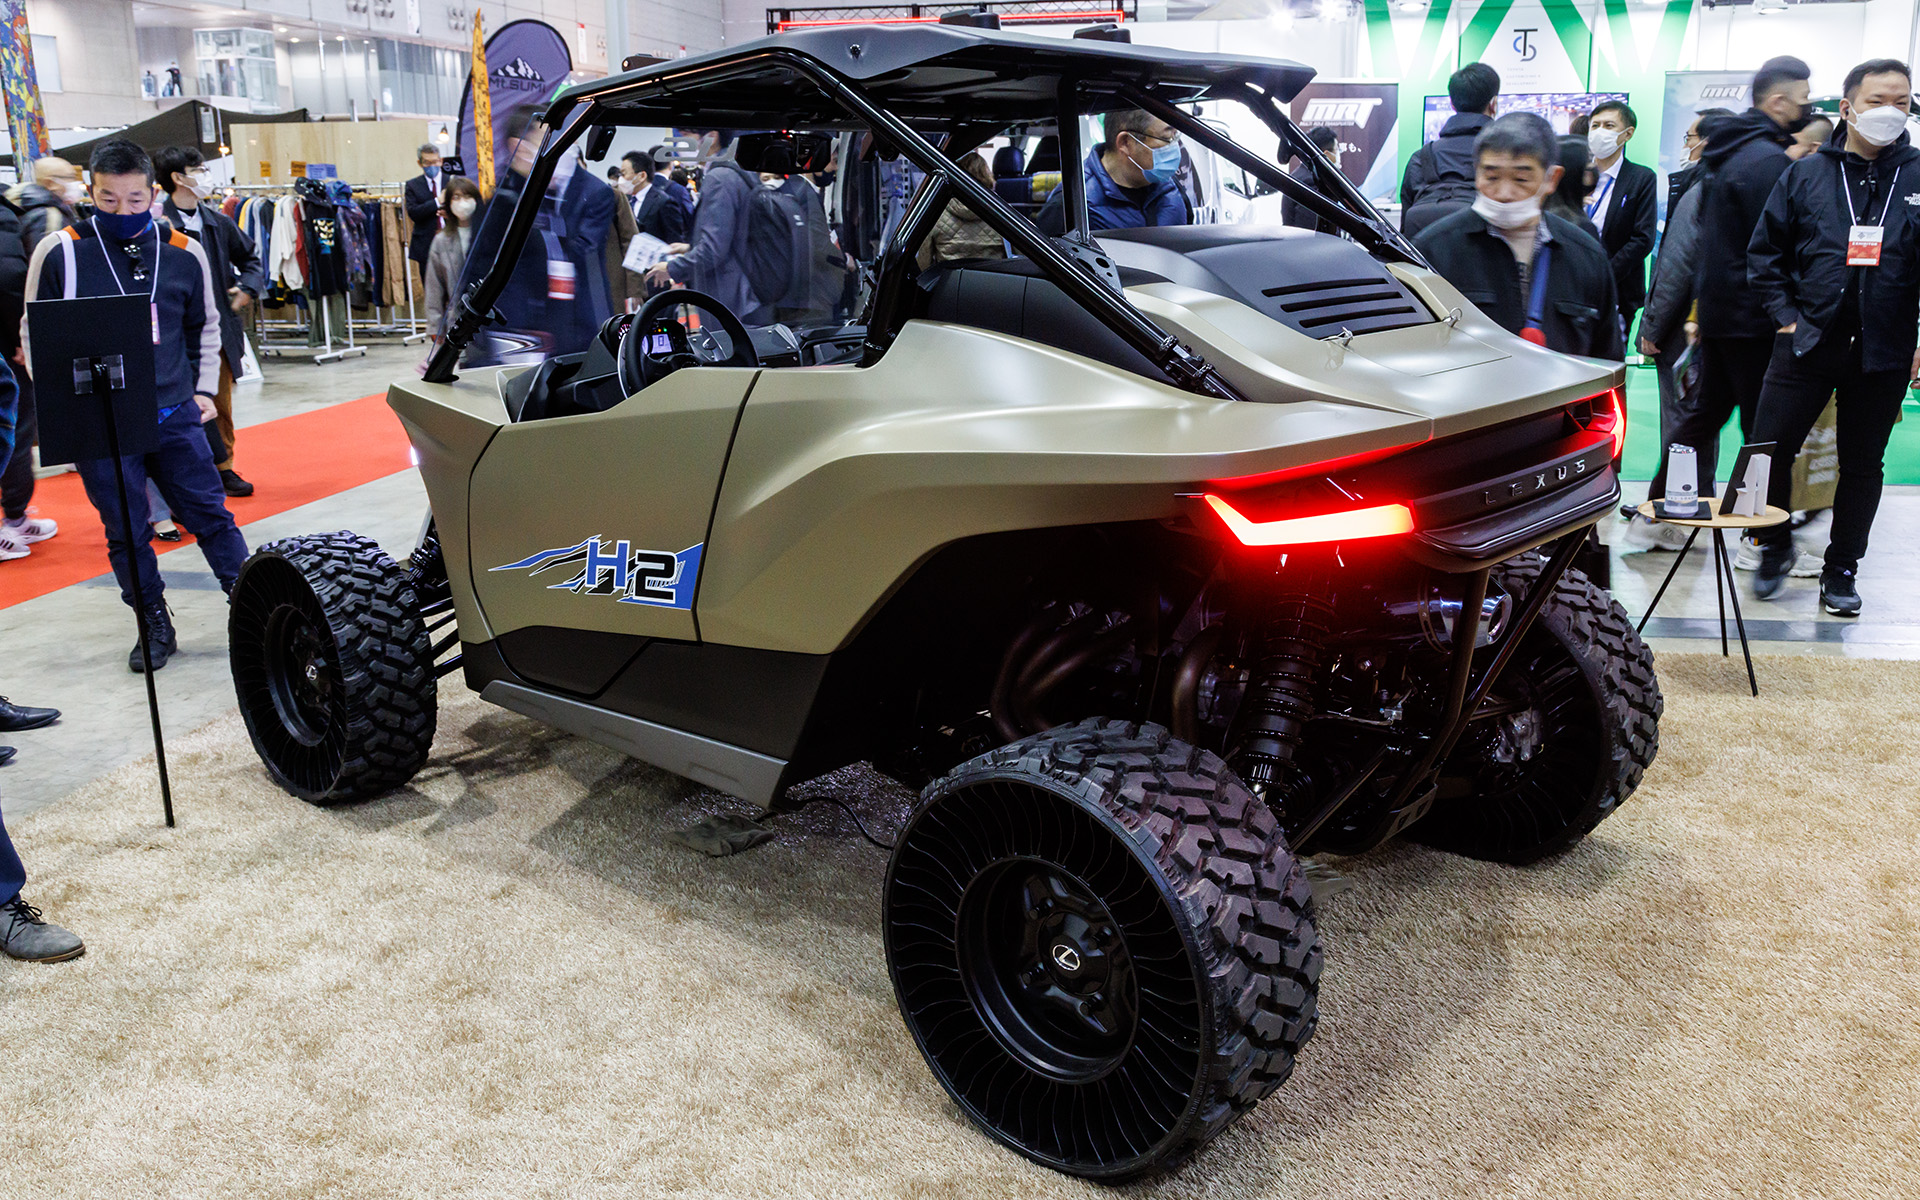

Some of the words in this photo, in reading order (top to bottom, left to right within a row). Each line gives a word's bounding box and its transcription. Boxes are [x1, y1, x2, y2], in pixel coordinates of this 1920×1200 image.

[1301, 98, 1383, 129] MRT
[1484, 459, 1585, 505] LEXUS
[584, 539, 678, 604] H2
